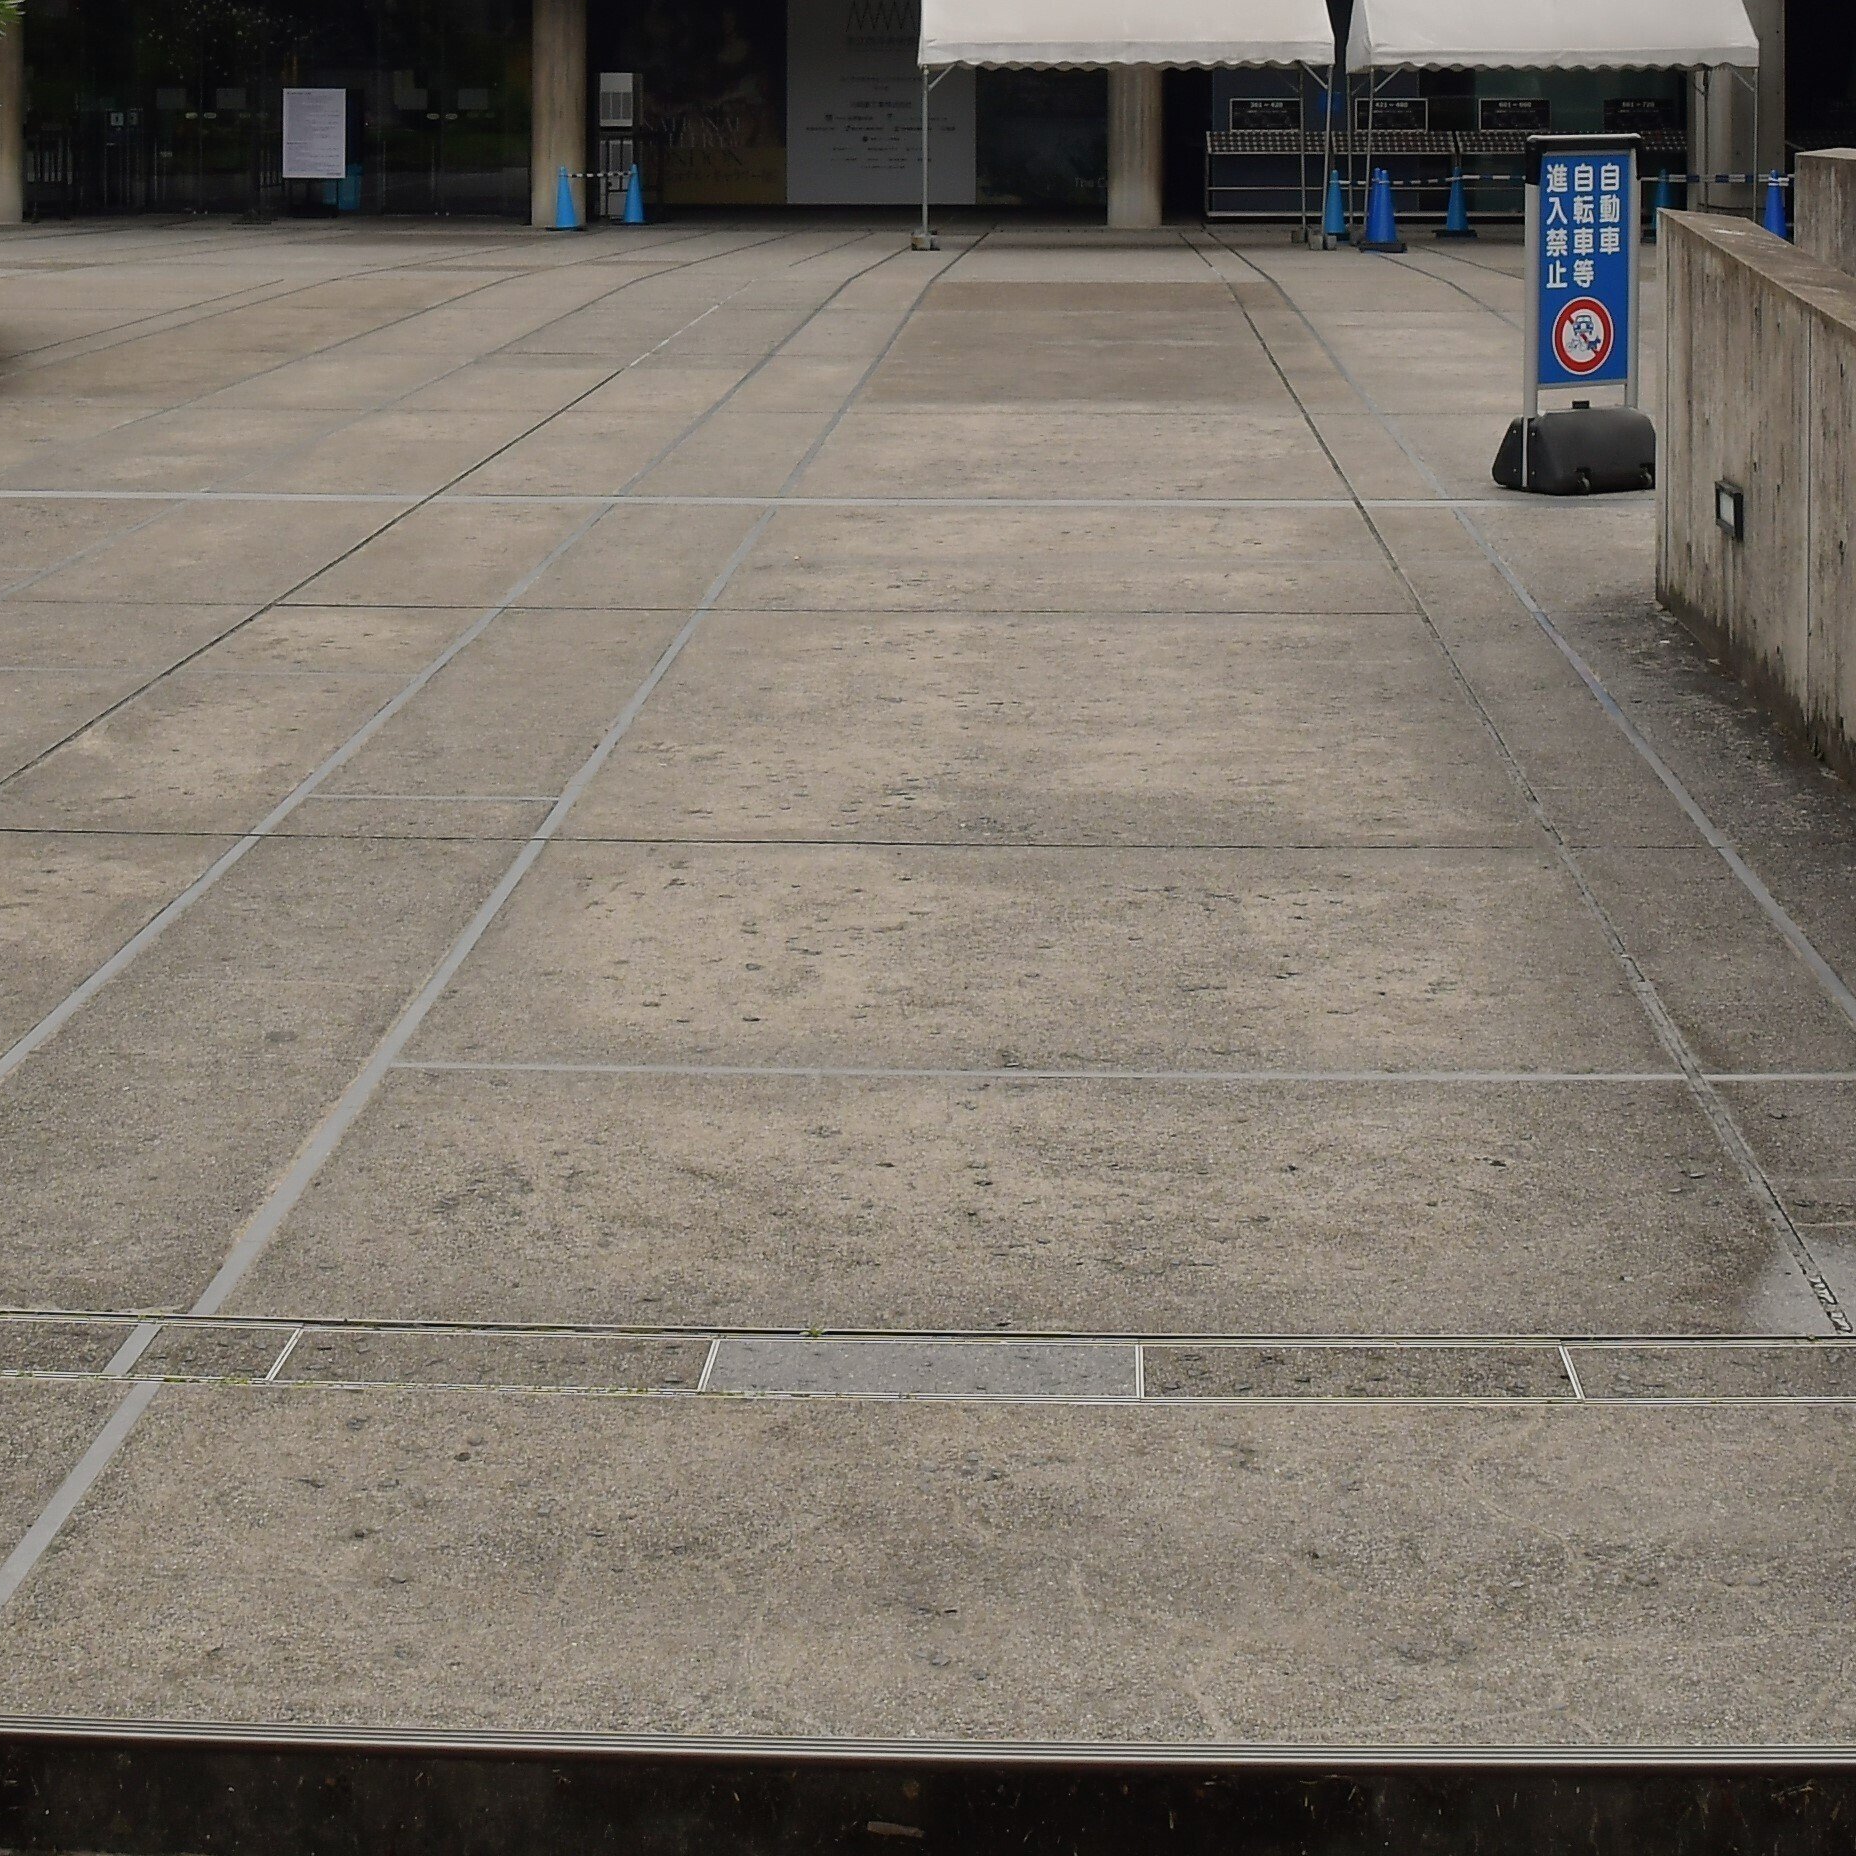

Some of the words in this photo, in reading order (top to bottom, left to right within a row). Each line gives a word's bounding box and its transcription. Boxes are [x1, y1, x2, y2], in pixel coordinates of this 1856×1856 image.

[1545, 164, 1568, 290] 進入禁止
[1572, 163, 1595, 289] 自転車等
[1599, 163, 1620, 255] 自動車
